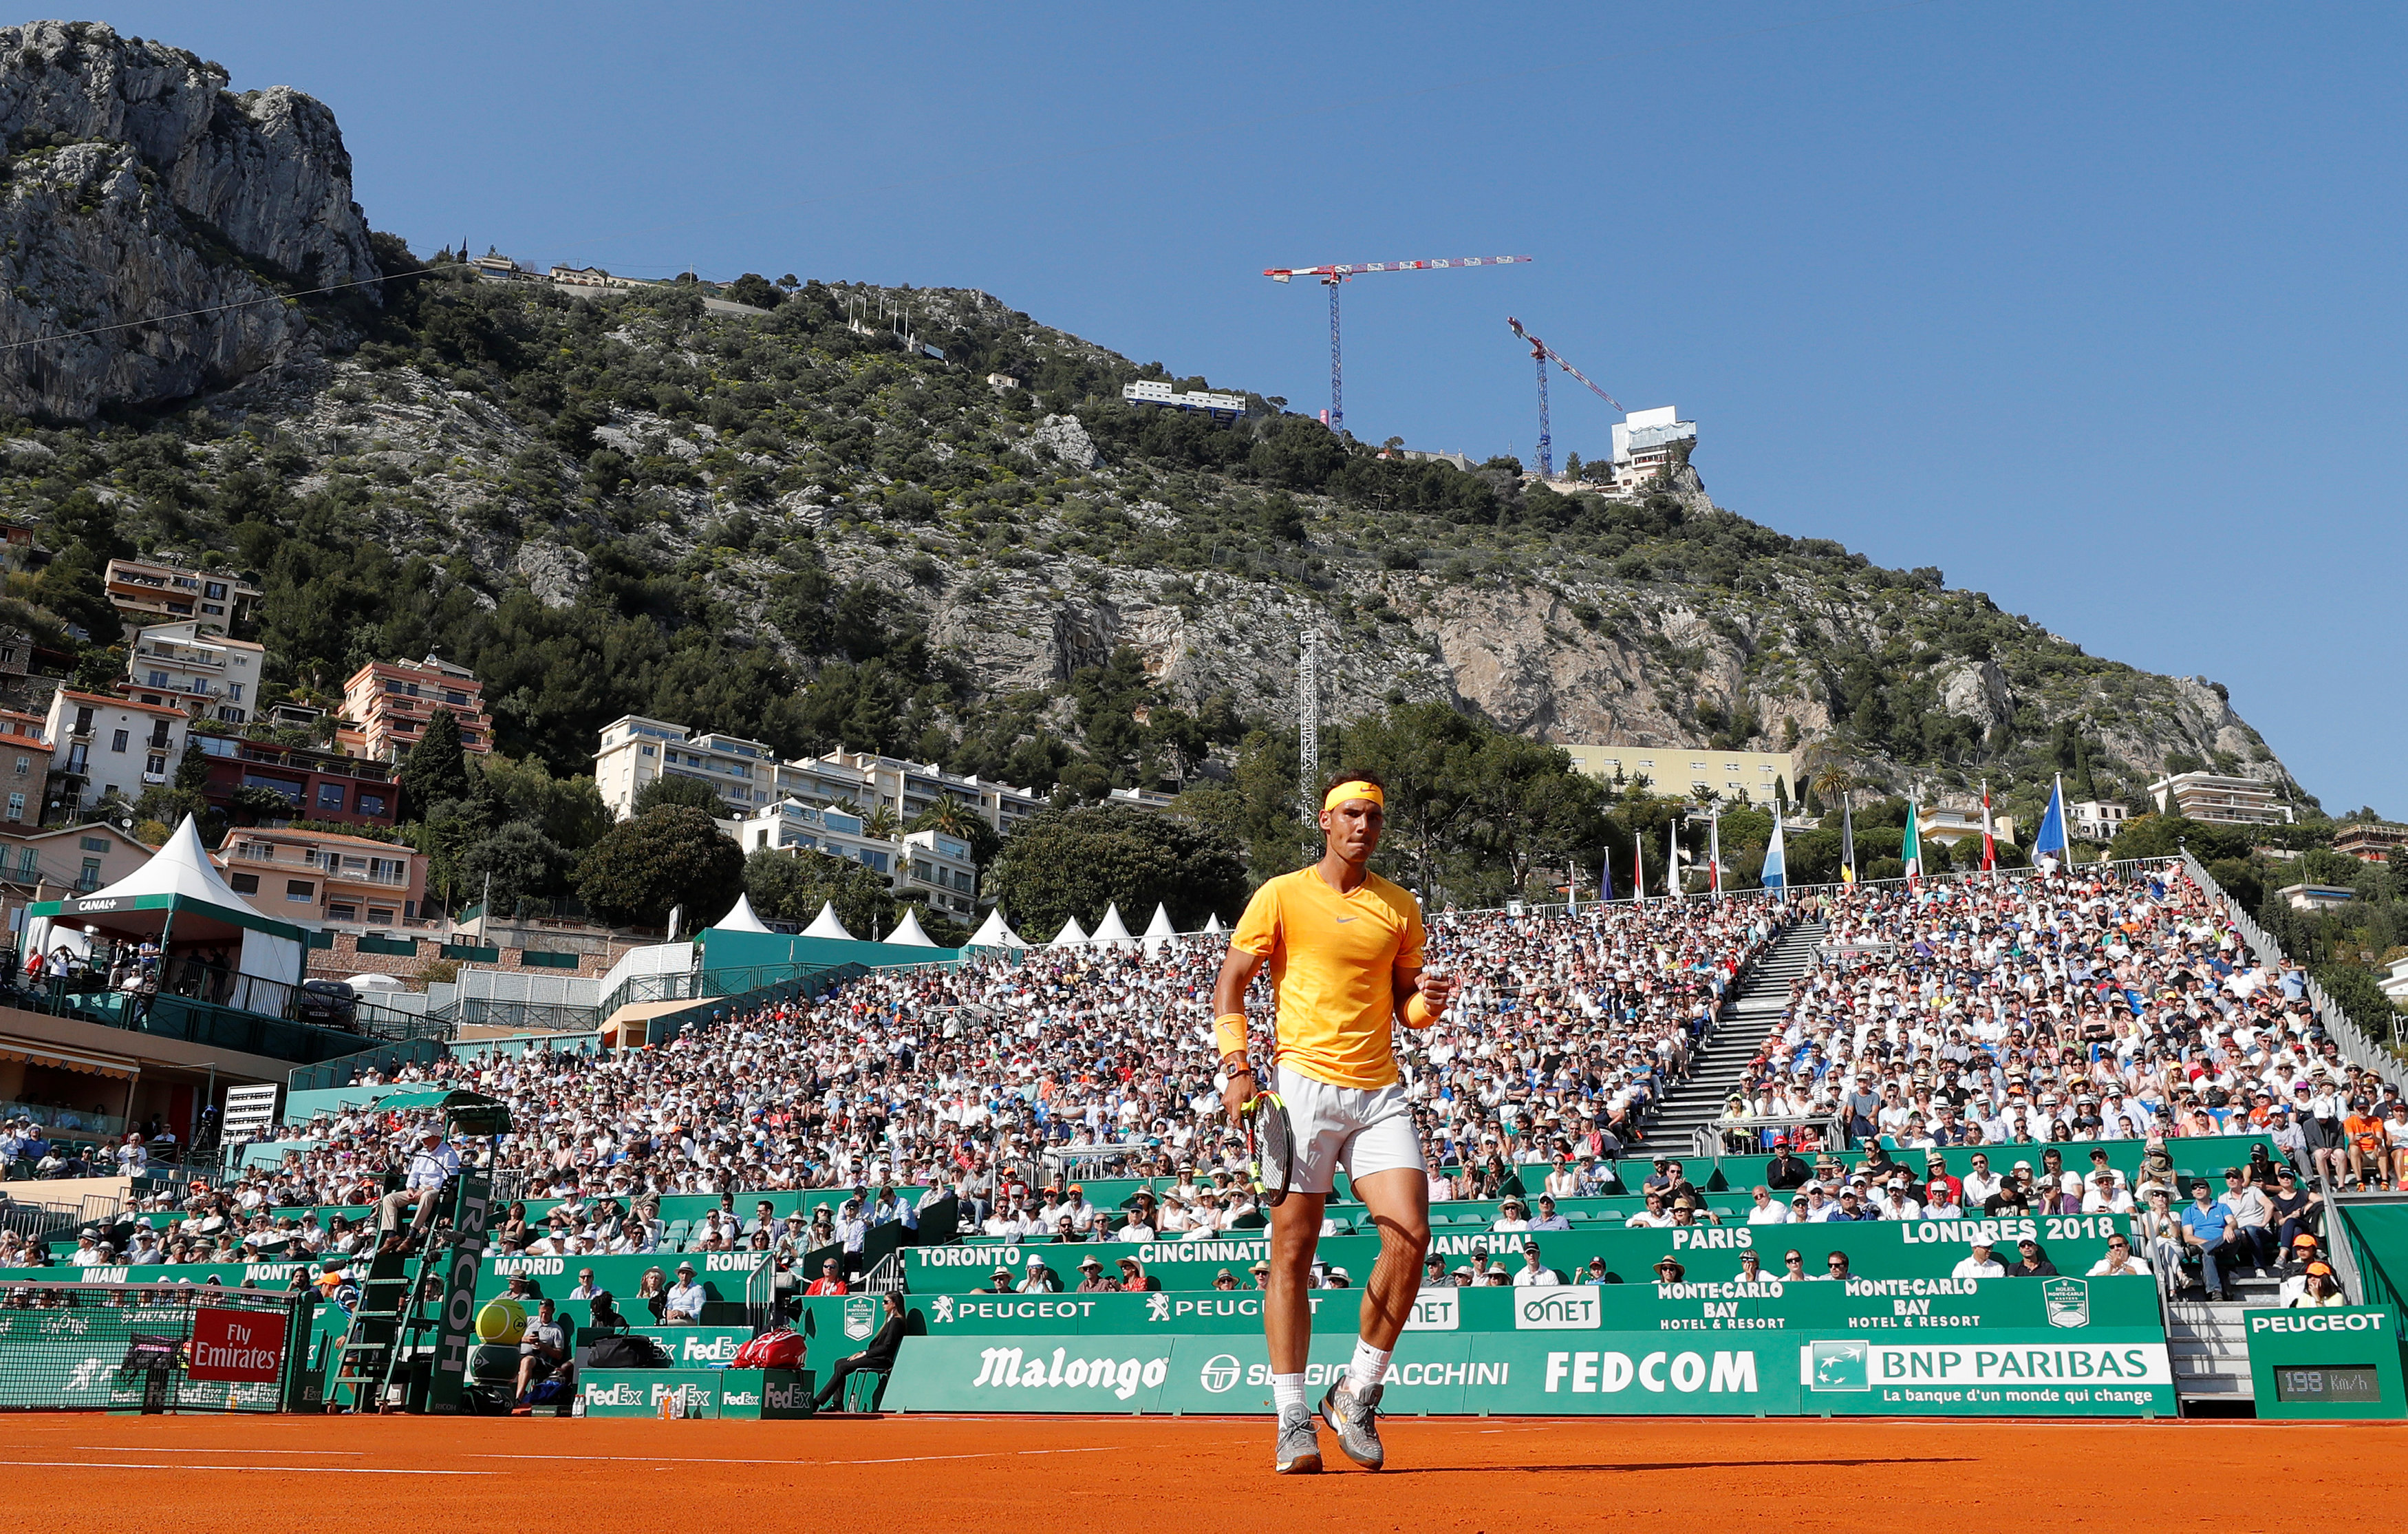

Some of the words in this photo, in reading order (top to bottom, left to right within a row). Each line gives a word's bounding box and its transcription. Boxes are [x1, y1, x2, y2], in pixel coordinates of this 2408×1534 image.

[78, 899, 117, 911] CANAL+
[468, 1178, 488, 1186] RICOH
[1673, 1228, 1752, 1249] PARIS
[1902, 1220, 2038, 1244] LONDRES
[2045, 1217, 2116, 1241] 2018
[918, 1246, 1020, 1267] TORONTO
[1139, 1241, 1271, 1263] CINCINNATI
[494, 1258, 564, 1275] MADRID
[706, 1253, 762, 1271] ROME
[81, 1267, 129, 1283] MIAMI
[245, 1264, 304, 1281] MONT
[441, 1196, 486, 1372] RICOH
[1657, 1282, 1783, 1299] MONTE-CARLO
[1845, 1278, 1977, 1297] MONTE-CARLO
[958, 1301, 1096, 1318] PEUGEOT
[1175, 1298, 1324, 1317] PEUGT
[1703, 1301, 1739, 1318] BAY
[1893, 1299, 1931, 1316] BAY
[1660, 1319, 1706, 1330] HOTEL
[1712, 1319, 1721, 1330] &
[1728, 1318, 1785, 1329] RESORT
[1848, 1317, 1898, 1328] HOTEL
[1904, 1317, 1913, 1328] &
[1919, 1316, 1981, 1327] RESORT
[2252, 1313, 2385, 1333] PEUGEOT
[227, 1324, 252, 1345] Fly
[195, 1341, 276, 1370] Emirates
[1883, 1352, 1961, 1378] BNP
[1975, 1350, 2148, 1377] PARIBAS
[973, 1347, 1168, 1400] Malongo
[1379, 1362, 1509, 1386] ACCHINI
[1545, 1350, 1759, 1393] FEDCOM
[2286, 1372, 2323, 1392] 198
[2330, 1374, 2367, 1390] Km/h
[585, 1383, 643, 1406] FedEx
[723, 1392, 760, 1405] FedEx
[764, 1383, 811, 1409] FedEx
[1883, 1389, 1902, 1401] La
[1905, 1389, 1961, 1405] banque
[1966, 1388, 2001, 1402] d'un
[2006, 1388, 2060, 1402] monde
[2065, 1389, 2089, 1405] qui
[2094, 1388, 2153, 1405] change
